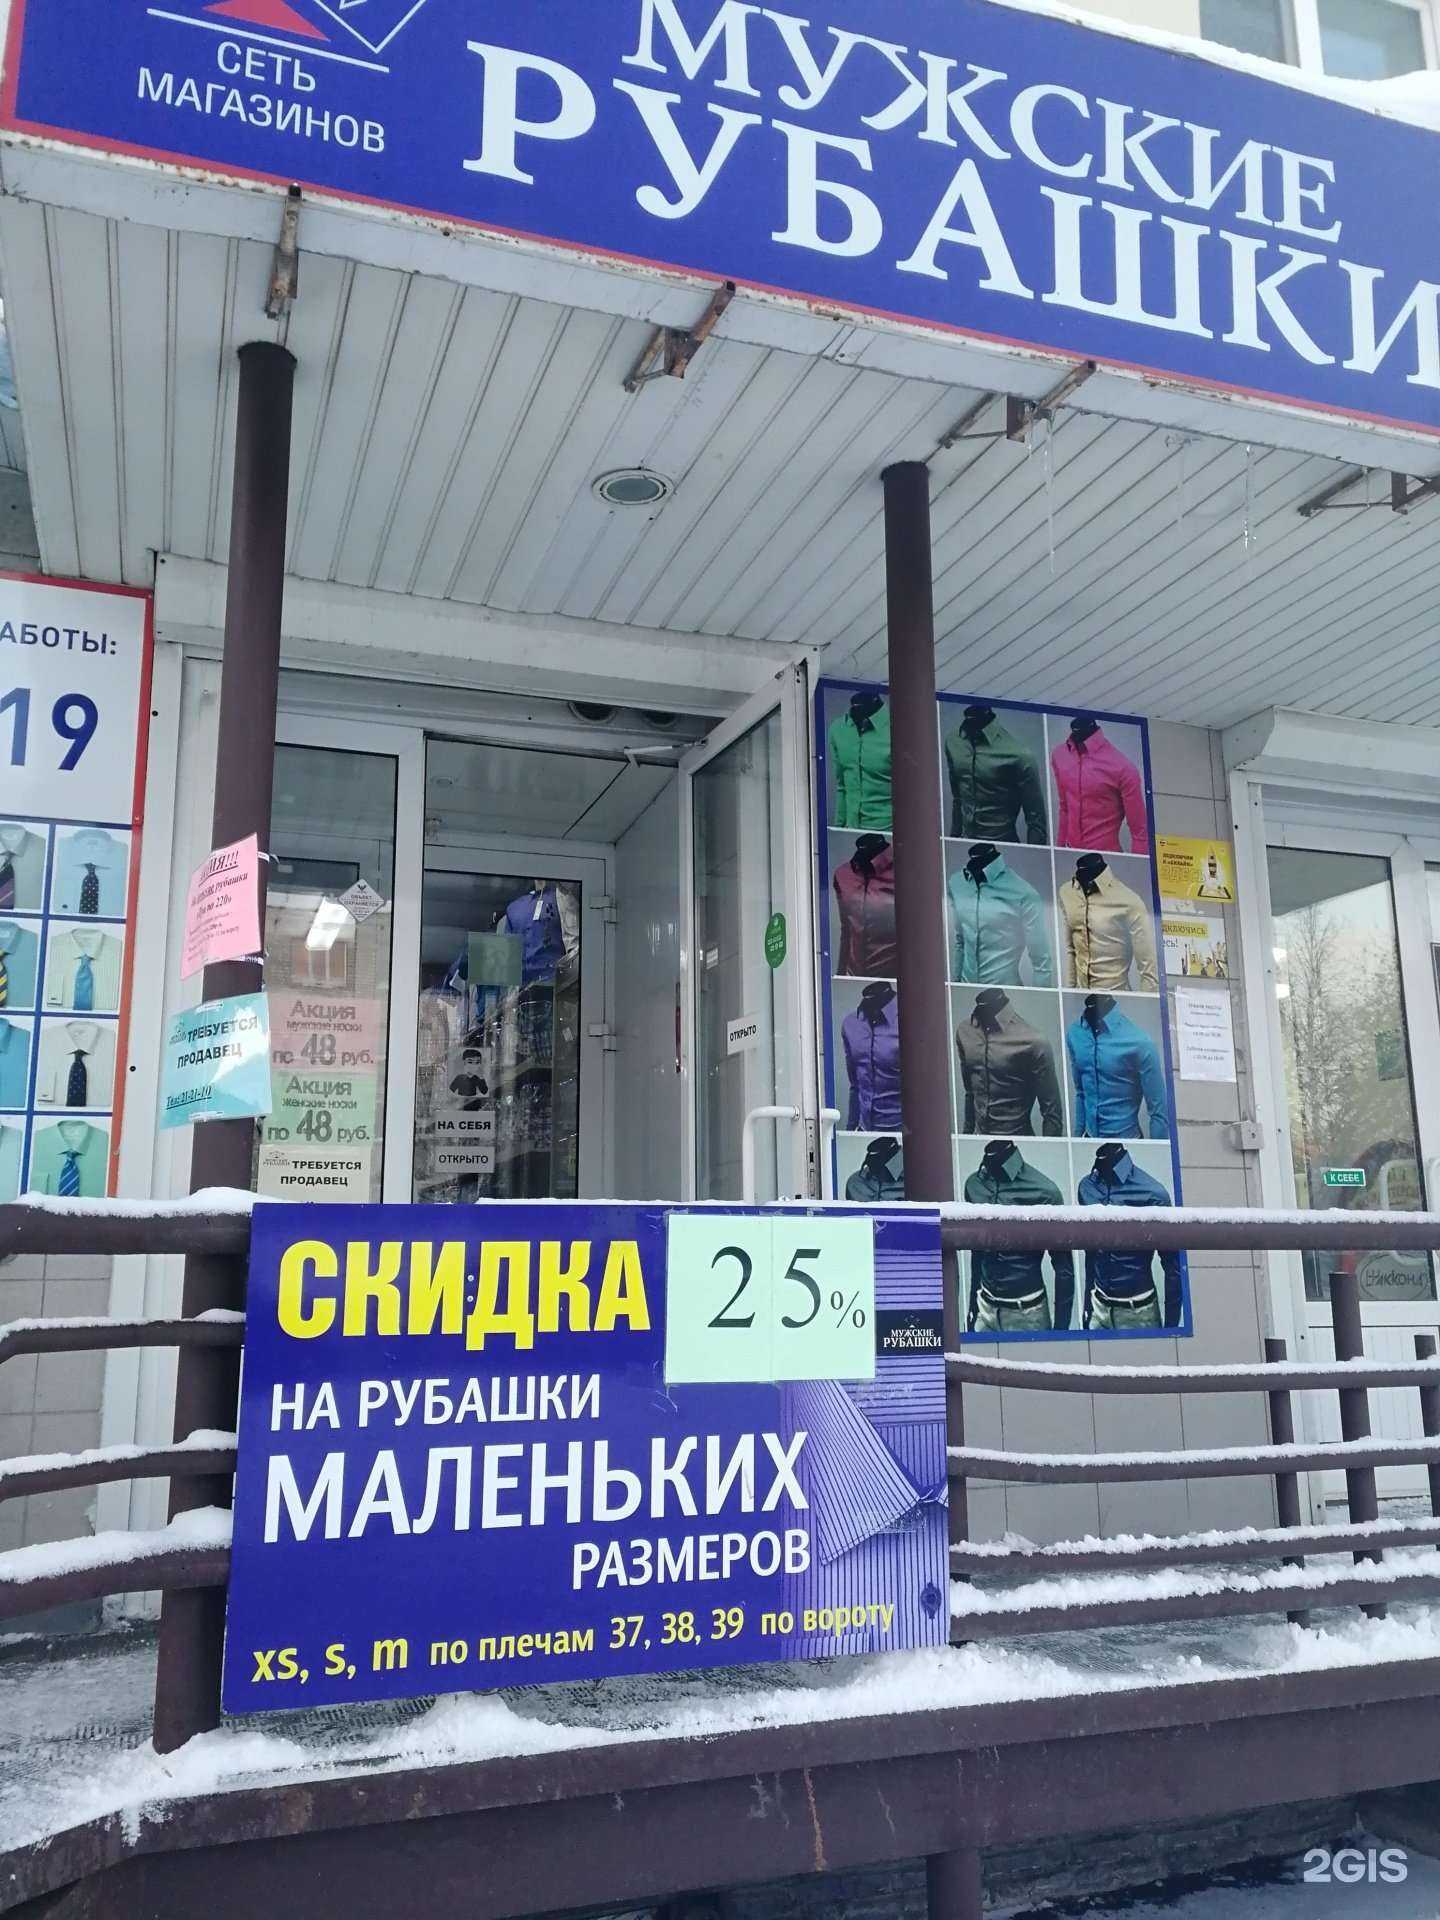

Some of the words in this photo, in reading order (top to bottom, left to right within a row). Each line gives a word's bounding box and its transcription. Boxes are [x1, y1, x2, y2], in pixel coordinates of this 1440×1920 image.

[216, 41, 316, 92] СЕТЬ
[137, 66, 386, 153] МАГАЗИНОВ
[621, 0, 1342, 243] МУЖСКИЕ
[462, 40, 1440, 390] РУБАШКИ
[187, 1016, 258, 1043] ТРЕБУЕТСЯ
[729, 1024, 758, 1042] ОТКРЫТО
[177, 1042, 242, 1069] ПРОДАВЕЦ
[272, 1050, 294, 1065] по
[301, 1032, 337, 1066] 48
[341, 1049, 374, 1066] руб.
[267, 1126, 290, 1141] по
[296, 1110, 334, 1143] 48
[336, 1125, 371, 1143] руб.
[437, 1121, 455, 1130] НА
[458, 1120, 491, 1131] СЕБЯ
[292, 1160, 362, 1170] ТРЕБУЕТСЯ
[438, 1154, 489, 1165] ОТКРЫТО
[280, 1175, 349, 1187] ПРОДАВЕЦ
[1330, 1174, 1337, 1182] К
[1337, 1174, 1360, 1183] СЕБЕ
[277, 1240, 651, 1351] СКИДКА
[883, 1336, 942, 1348] РУБАШКИ
[891, 1328, 935, 1338] МУЖСКИЕ
[270, 1382, 341, 1432] НА
[358, 1373, 601, 1428] РУБАШКИ
[264, 1431, 809, 1543] МАЛЕНЬКИХ
[572, 1528, 811, 1590] РАЗМЕРОВ
[252, 1647, 309, 1684] xs,
[324, 1642, 357, 1680] s,
[372, 1637, 409, 1671] m
[430, 1637, 468, 1666] по
[478, 1624, 595, 1661] плечам
[609, 1615, 651, 1650] 37,
[659, 1610, 702, 1645] 38,
[710, 1606, 744, 1639] 39
[760, 1607, 794, 1636] по
[802, 1601, 895, 1634] вороту
